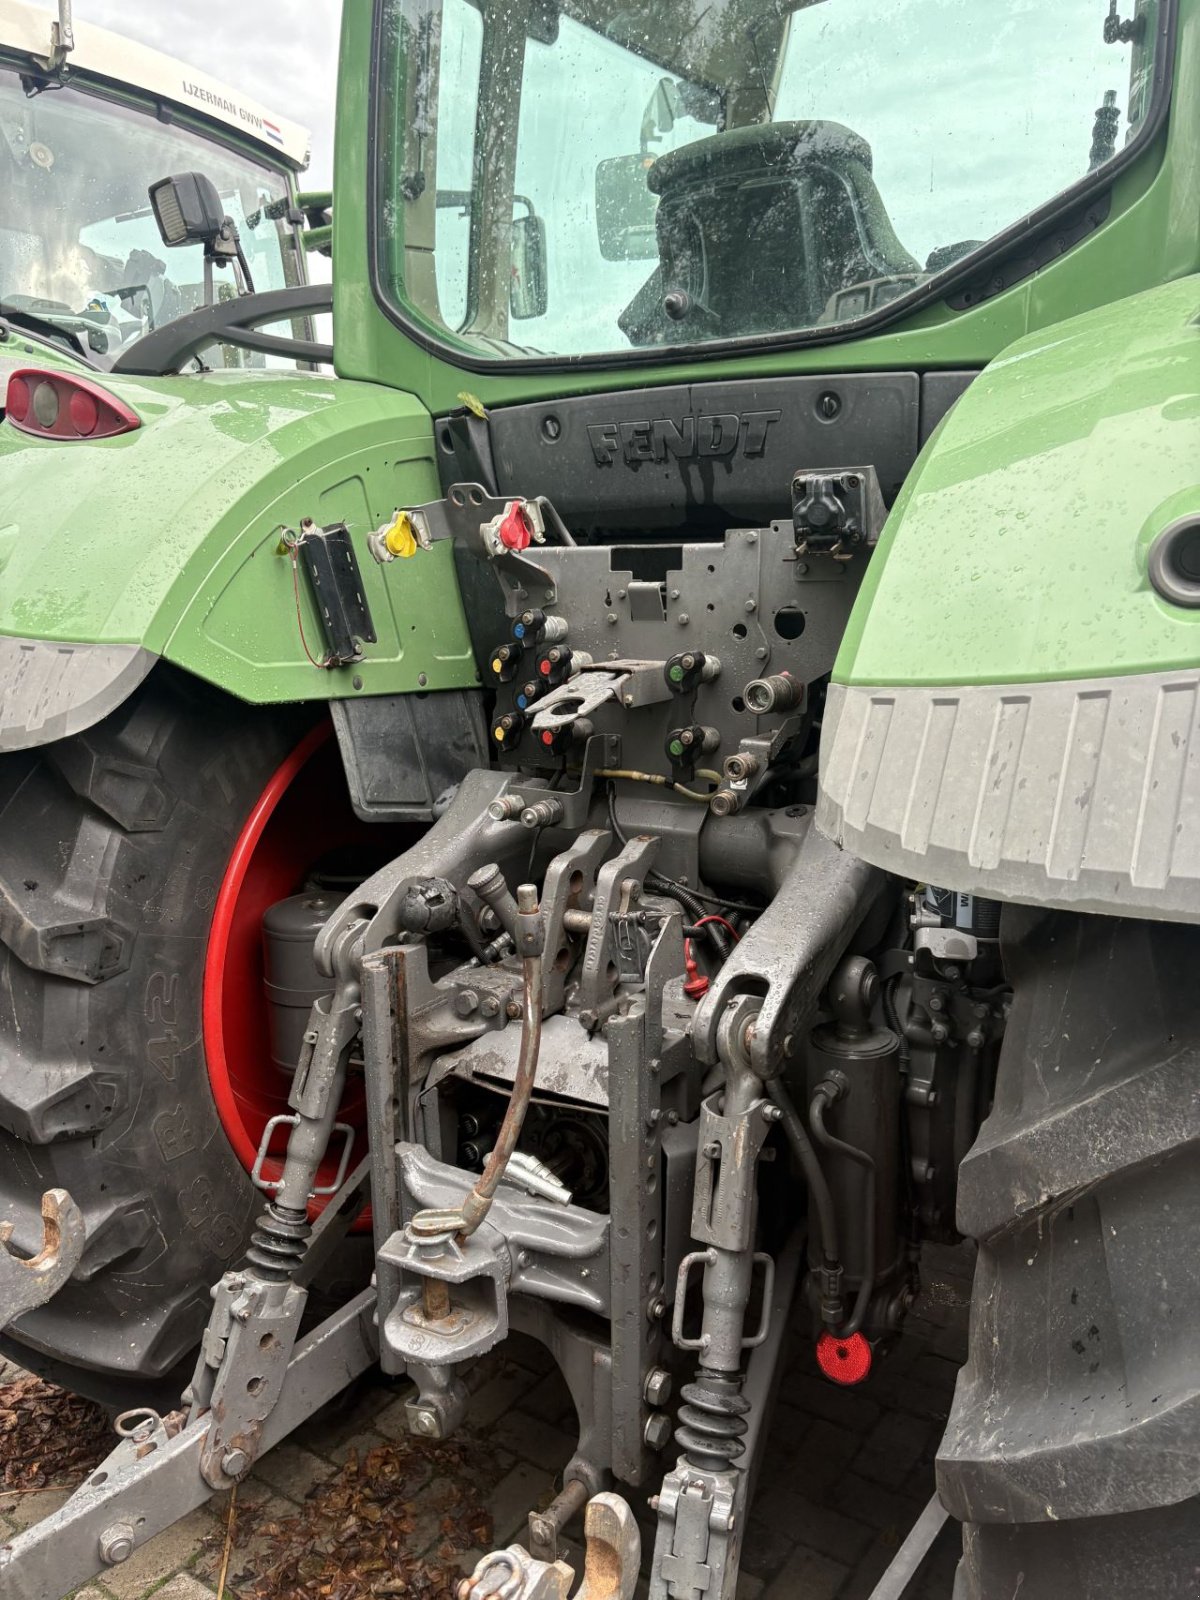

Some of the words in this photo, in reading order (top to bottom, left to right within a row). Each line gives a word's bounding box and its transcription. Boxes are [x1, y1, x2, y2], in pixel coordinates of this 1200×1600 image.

[182, 80, 237, 116] IJZERMAN
[239, 108, 263, 129] GWW
[586, 409, 782, 465] FENDT
[145, 971, 180, 1081] 42
[151, 1103, 196, 1162] R
